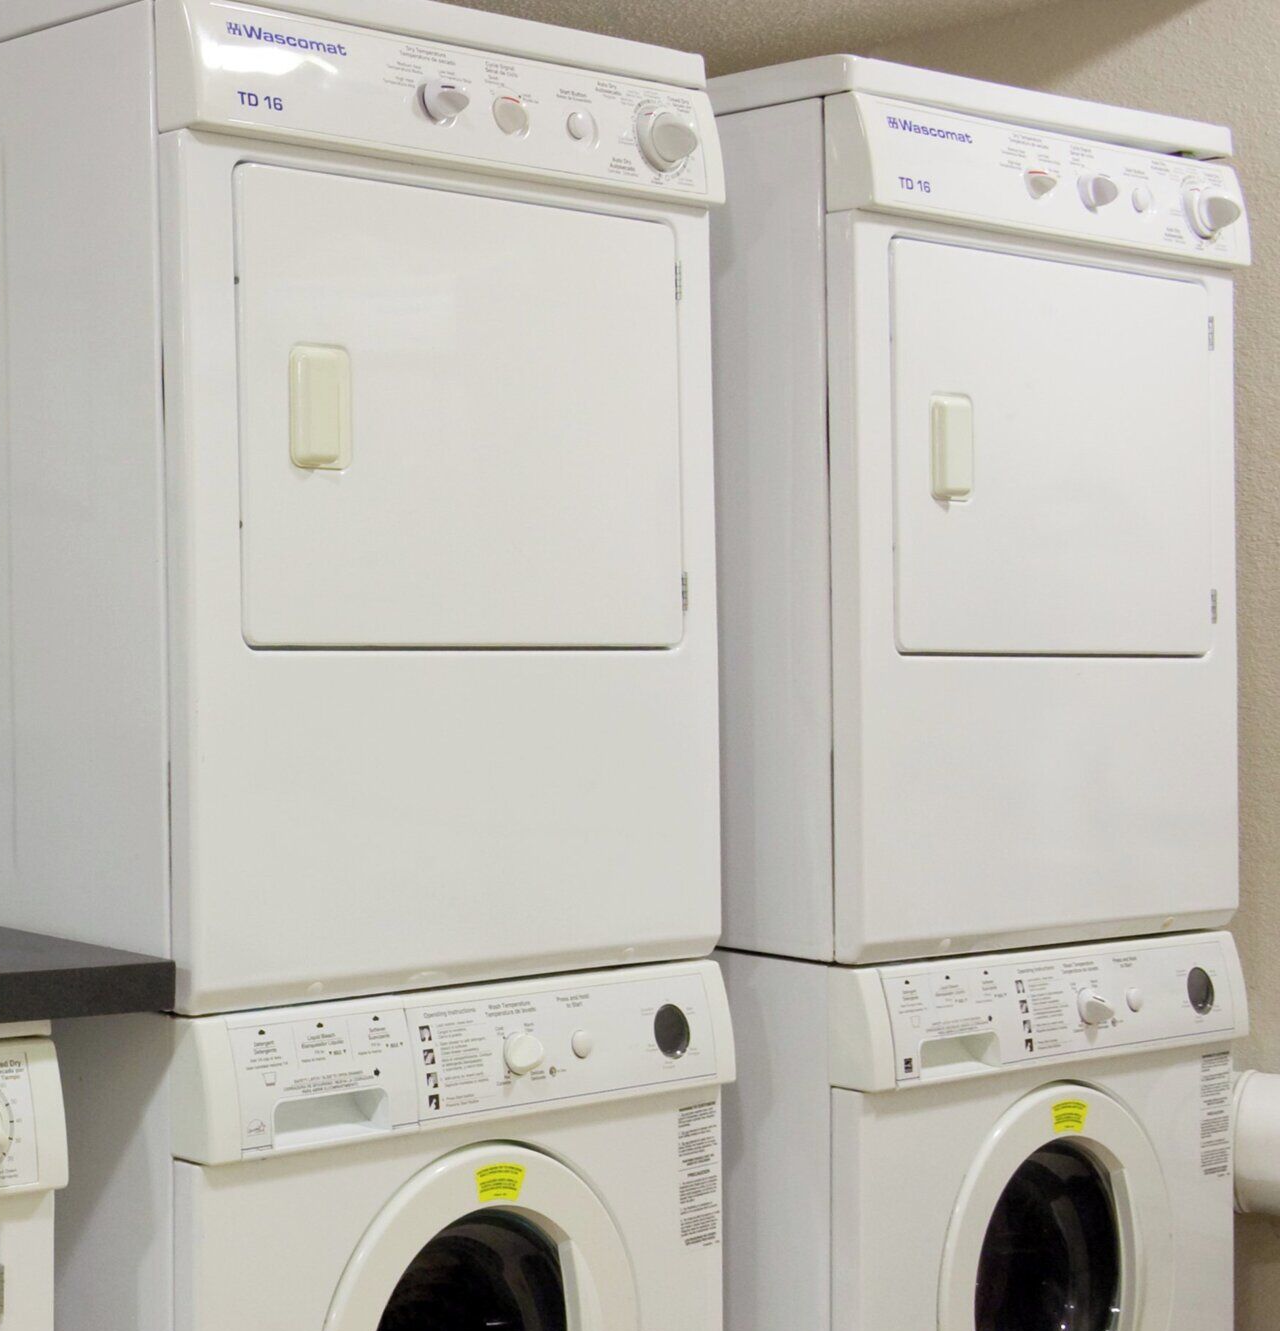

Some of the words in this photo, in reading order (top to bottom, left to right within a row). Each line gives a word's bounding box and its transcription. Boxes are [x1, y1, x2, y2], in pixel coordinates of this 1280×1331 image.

[244, 24, 346, 57] Wascomat
[237, 91, 260, 108] TD
[264, 94, 283, 112] 16
[899, 118, 972, 144] Wascomat
[899, 177, 914, 191] TD
[917, 180, 931, 194] 16
[10, 1059, 21, 1068] Dry
